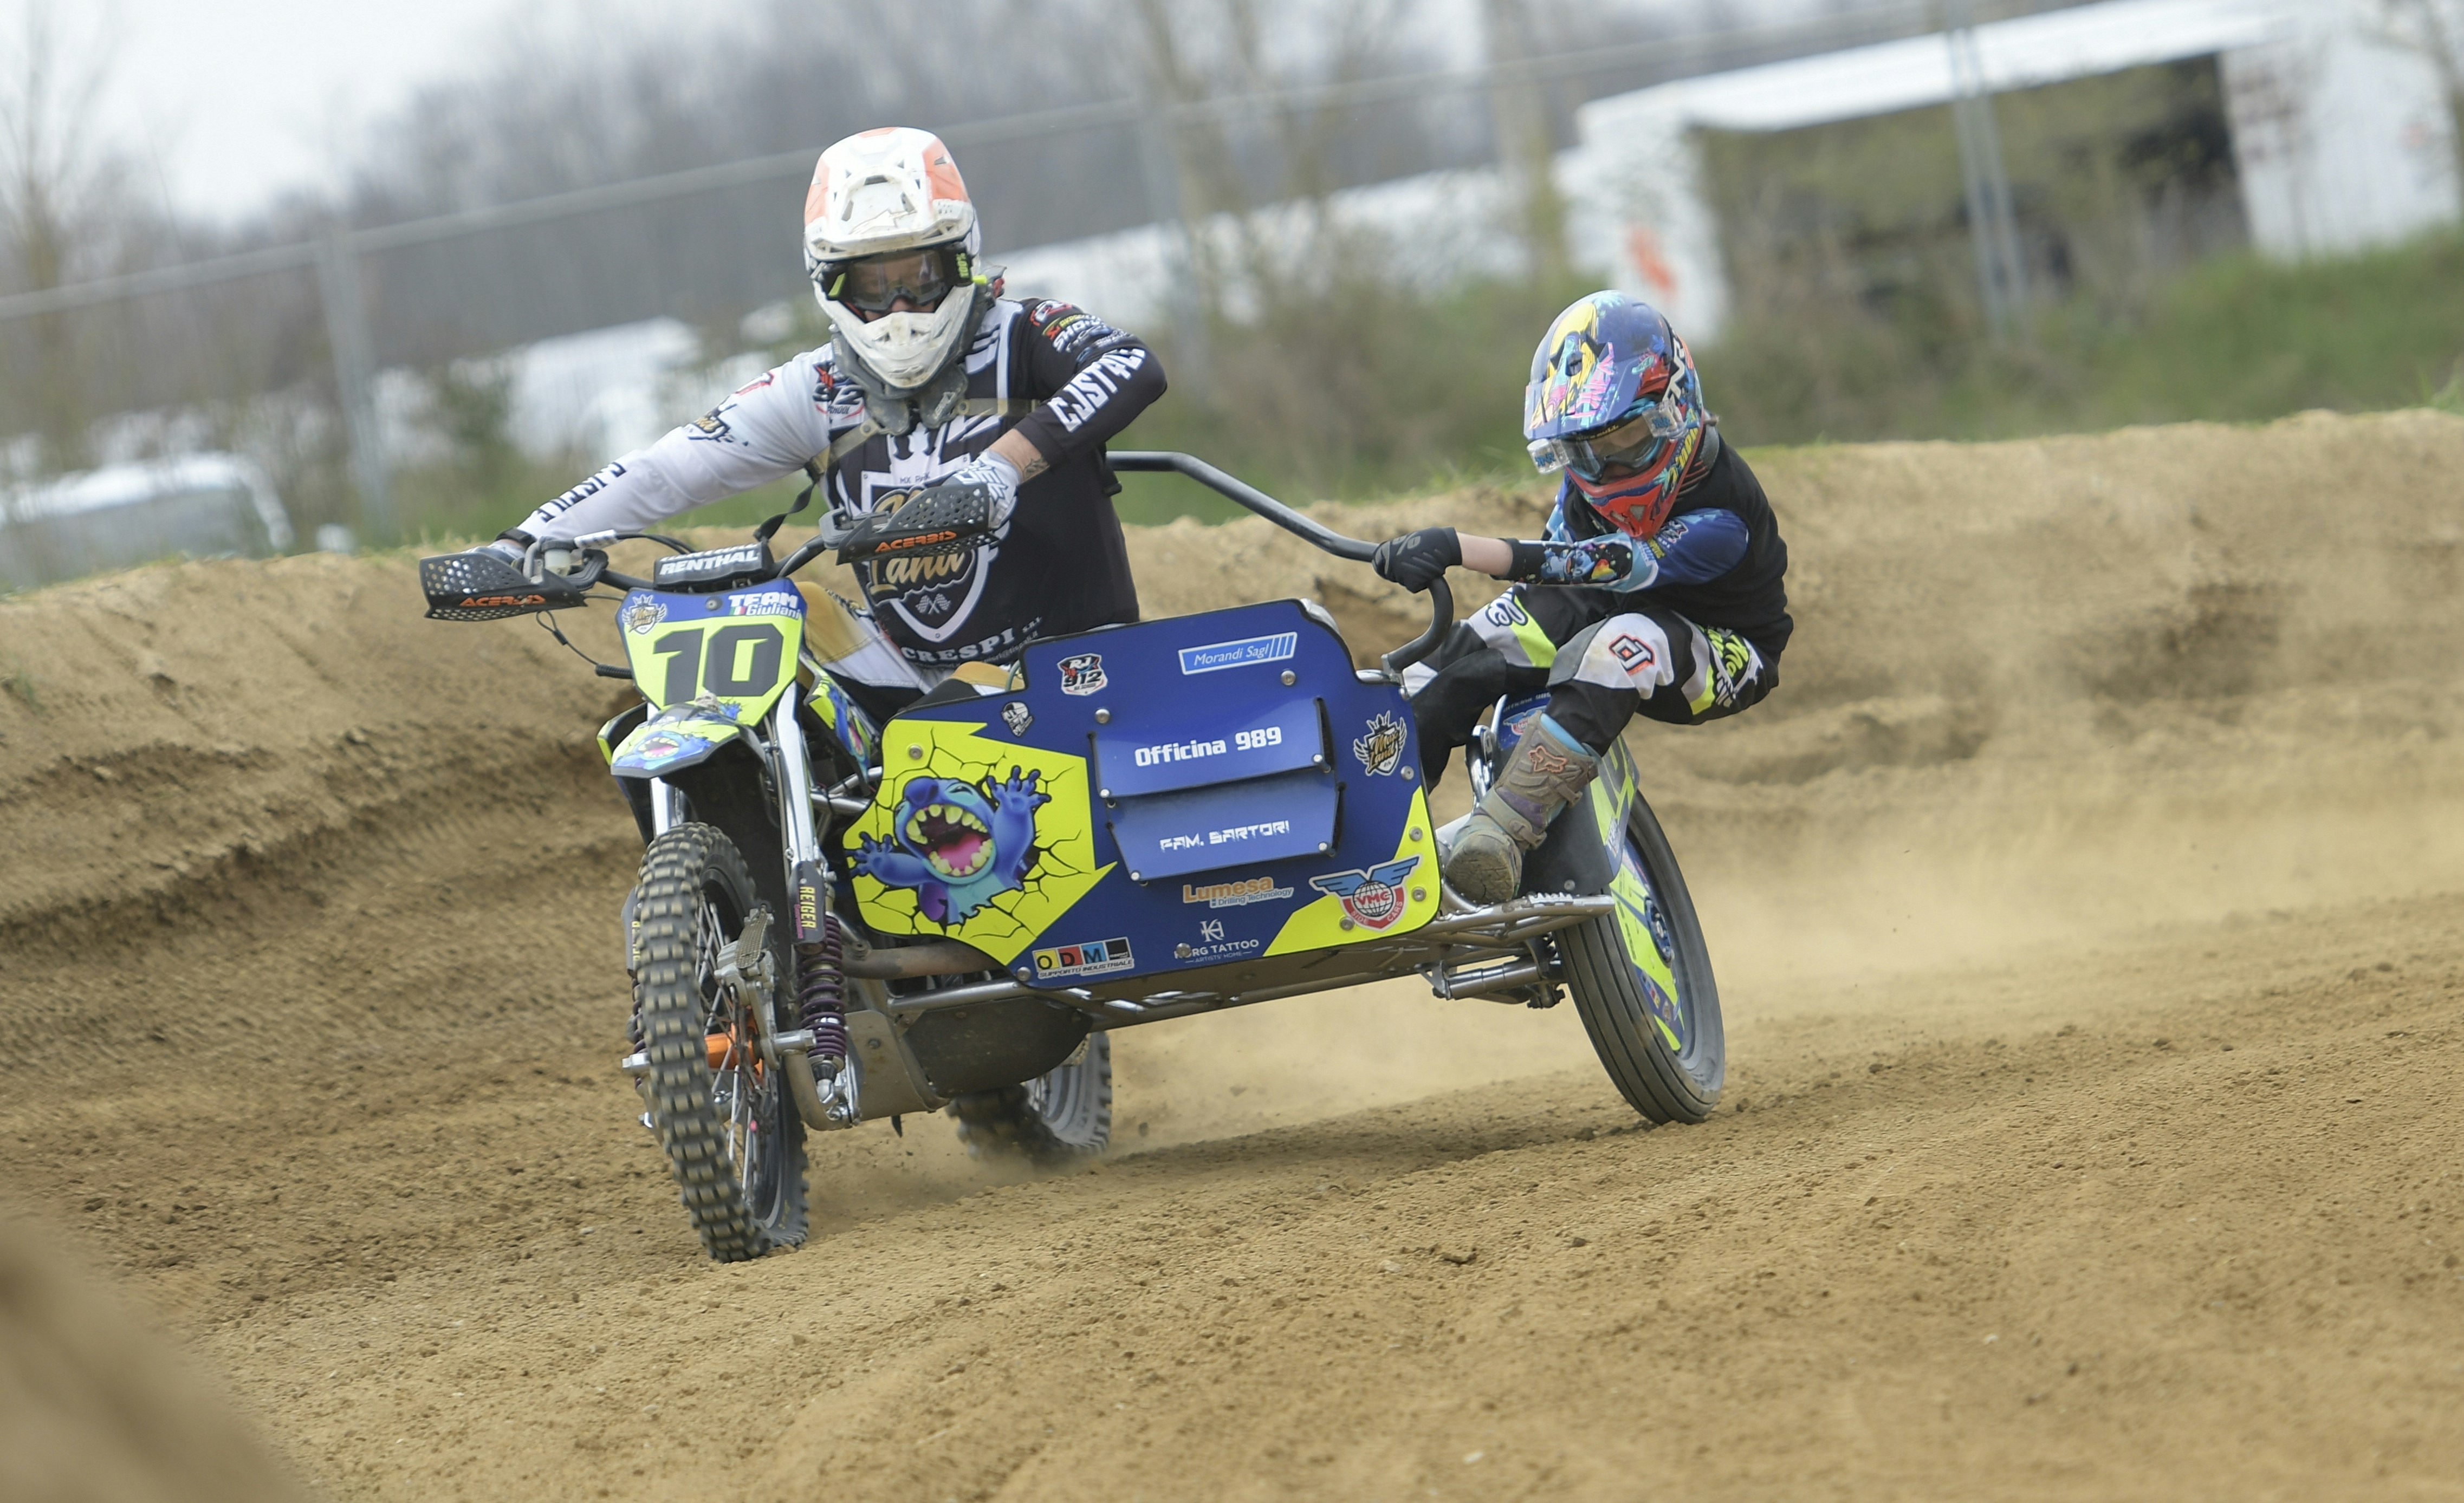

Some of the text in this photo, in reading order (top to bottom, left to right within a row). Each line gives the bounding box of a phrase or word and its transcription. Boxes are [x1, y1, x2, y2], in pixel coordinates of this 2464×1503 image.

[875, 531, 957, 552] ACERBIS
[659, 550, 758, 575] RENTHAL
[728, 592, 797, 608] TEAM
[747, 603, 801, 620] Giuliani
[901, 627, 1015, 662] CRESPI
[1194, 643, 1269, 666] Morandi Sagl
[652, 623, 784, 706] 10
[1134, 726, 1282, 767] Officina 989
[1159, 820, 1290, 853] FAM. SARTORI
[1184, 876, 1273, 902] Lumesa
[1218, 888, 1293, 906] Drilling Technology
[1356, 890, 1390, 906] VMC
[800, 886, 817, 928] REIGER
[1351, 901, 1403, 925] SIDE CARS
[1210, 939, 1259, 953] TATTOO
[1039, 960, 1132, 978] SUPPORTO INDUSTRIALE
